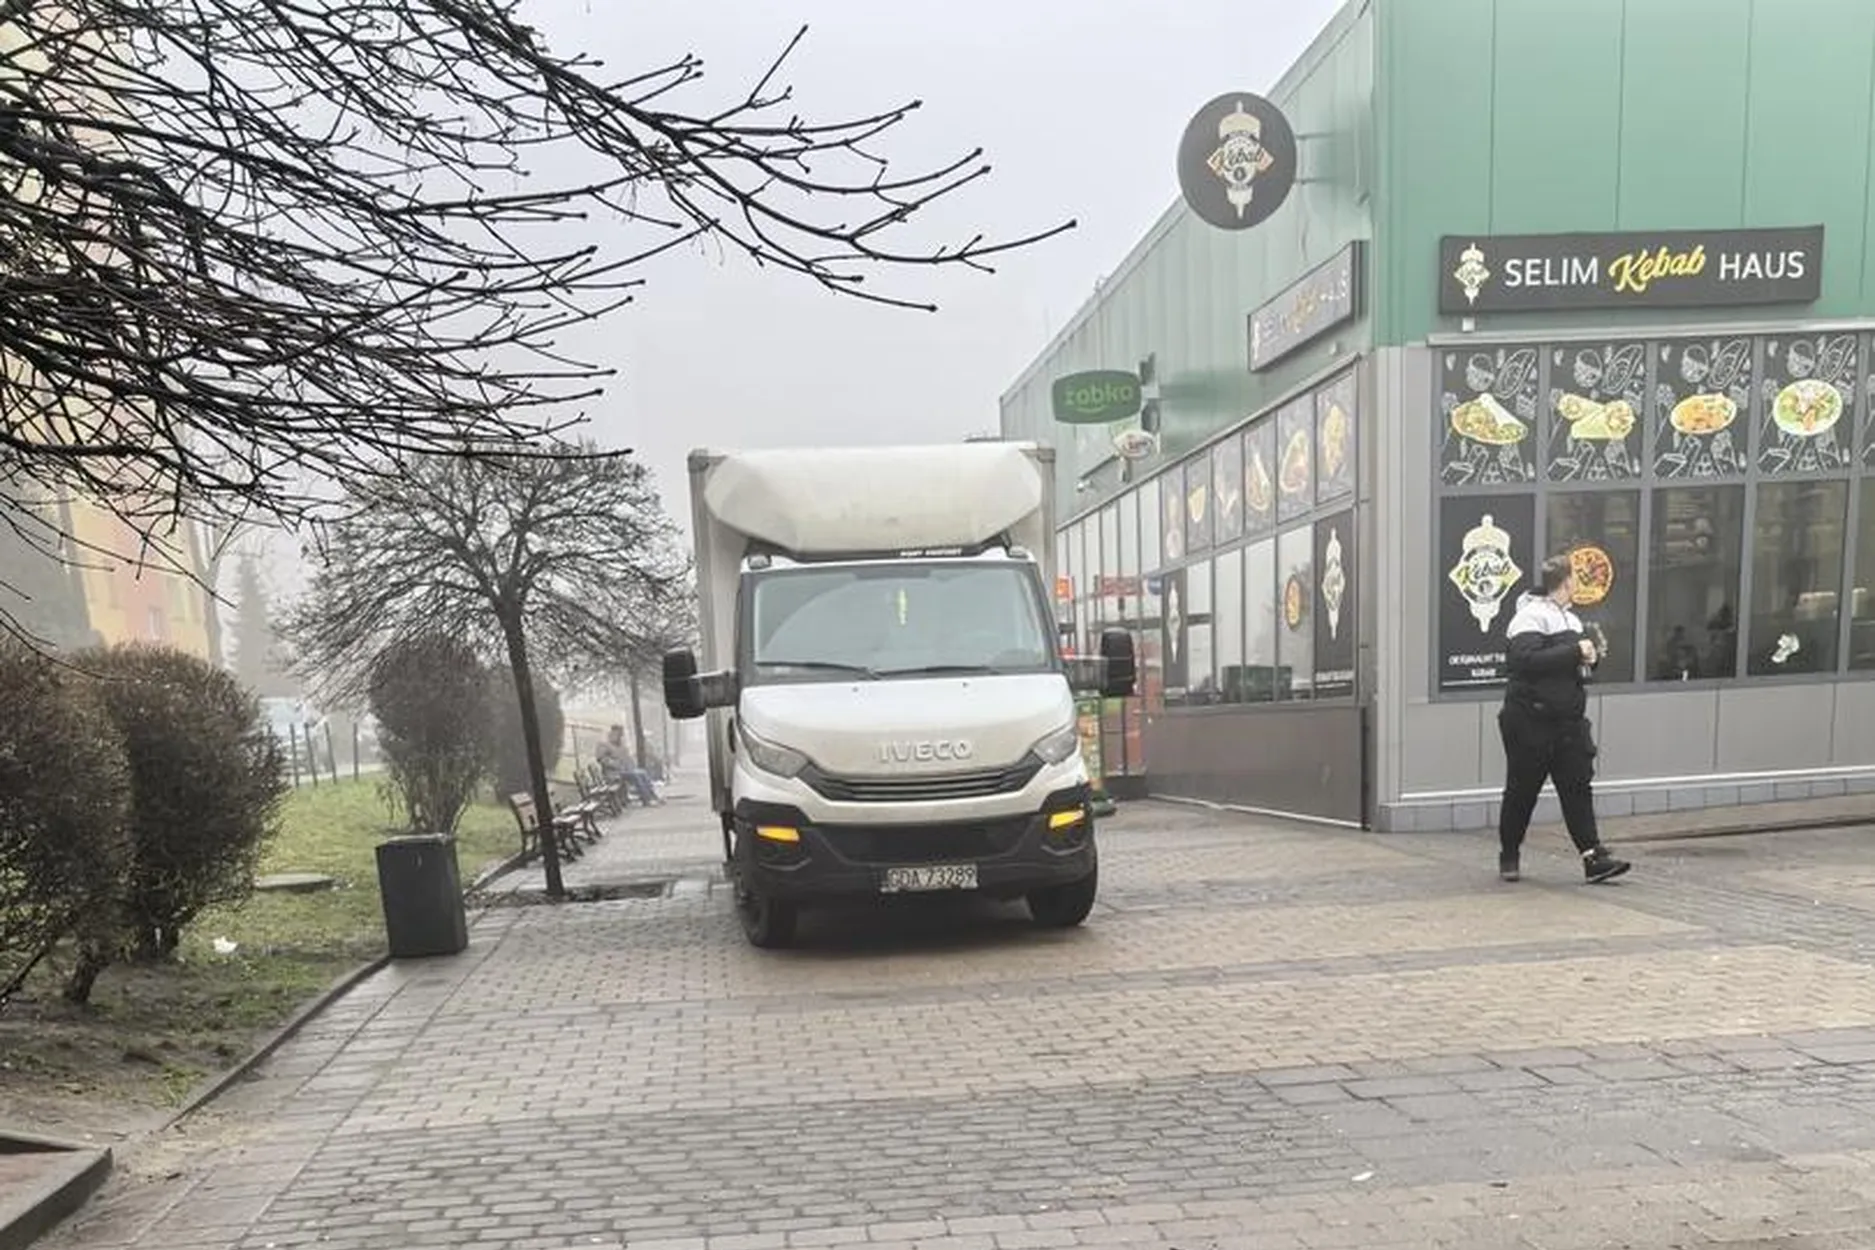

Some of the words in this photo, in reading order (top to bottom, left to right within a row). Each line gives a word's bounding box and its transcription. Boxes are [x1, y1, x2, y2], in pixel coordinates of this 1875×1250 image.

[1504, 257, 1599, 288] SELIM
[1608, 244, 1706, 293] Kebab
[1719, 250, 1804, 281] HAUS
[879, 740, 973, 763] IVECO
